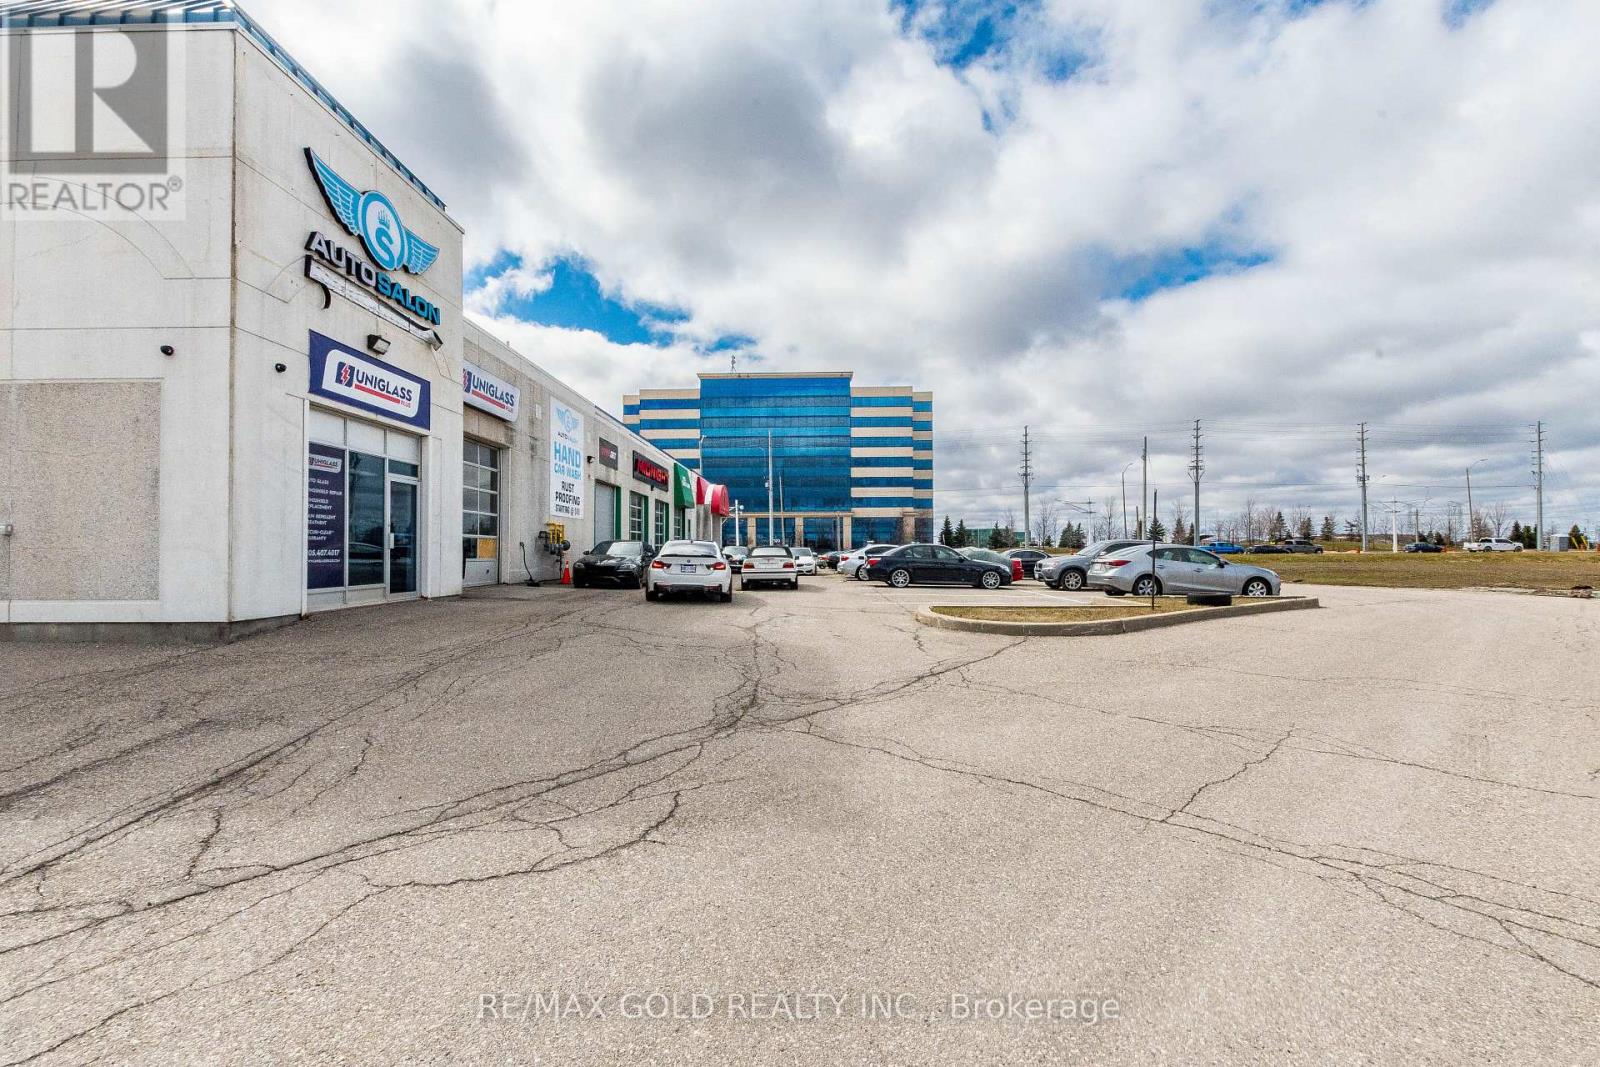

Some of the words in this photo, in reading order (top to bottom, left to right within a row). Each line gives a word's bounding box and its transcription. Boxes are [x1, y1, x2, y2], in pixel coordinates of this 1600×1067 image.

[304, 231, 440, 325] AUTOSALON
[356, 369, 412, 401] UNIGLASS
[472, 375, 515, 407] UNIGLASS
[554, 441, 581, 469] HAND
[554, 462, 566, 476] CAR
[566, 466, 582, 481] WASH
[555, 491, 581, 506] PROOFING
[561, 480, 575, 493] RUST
